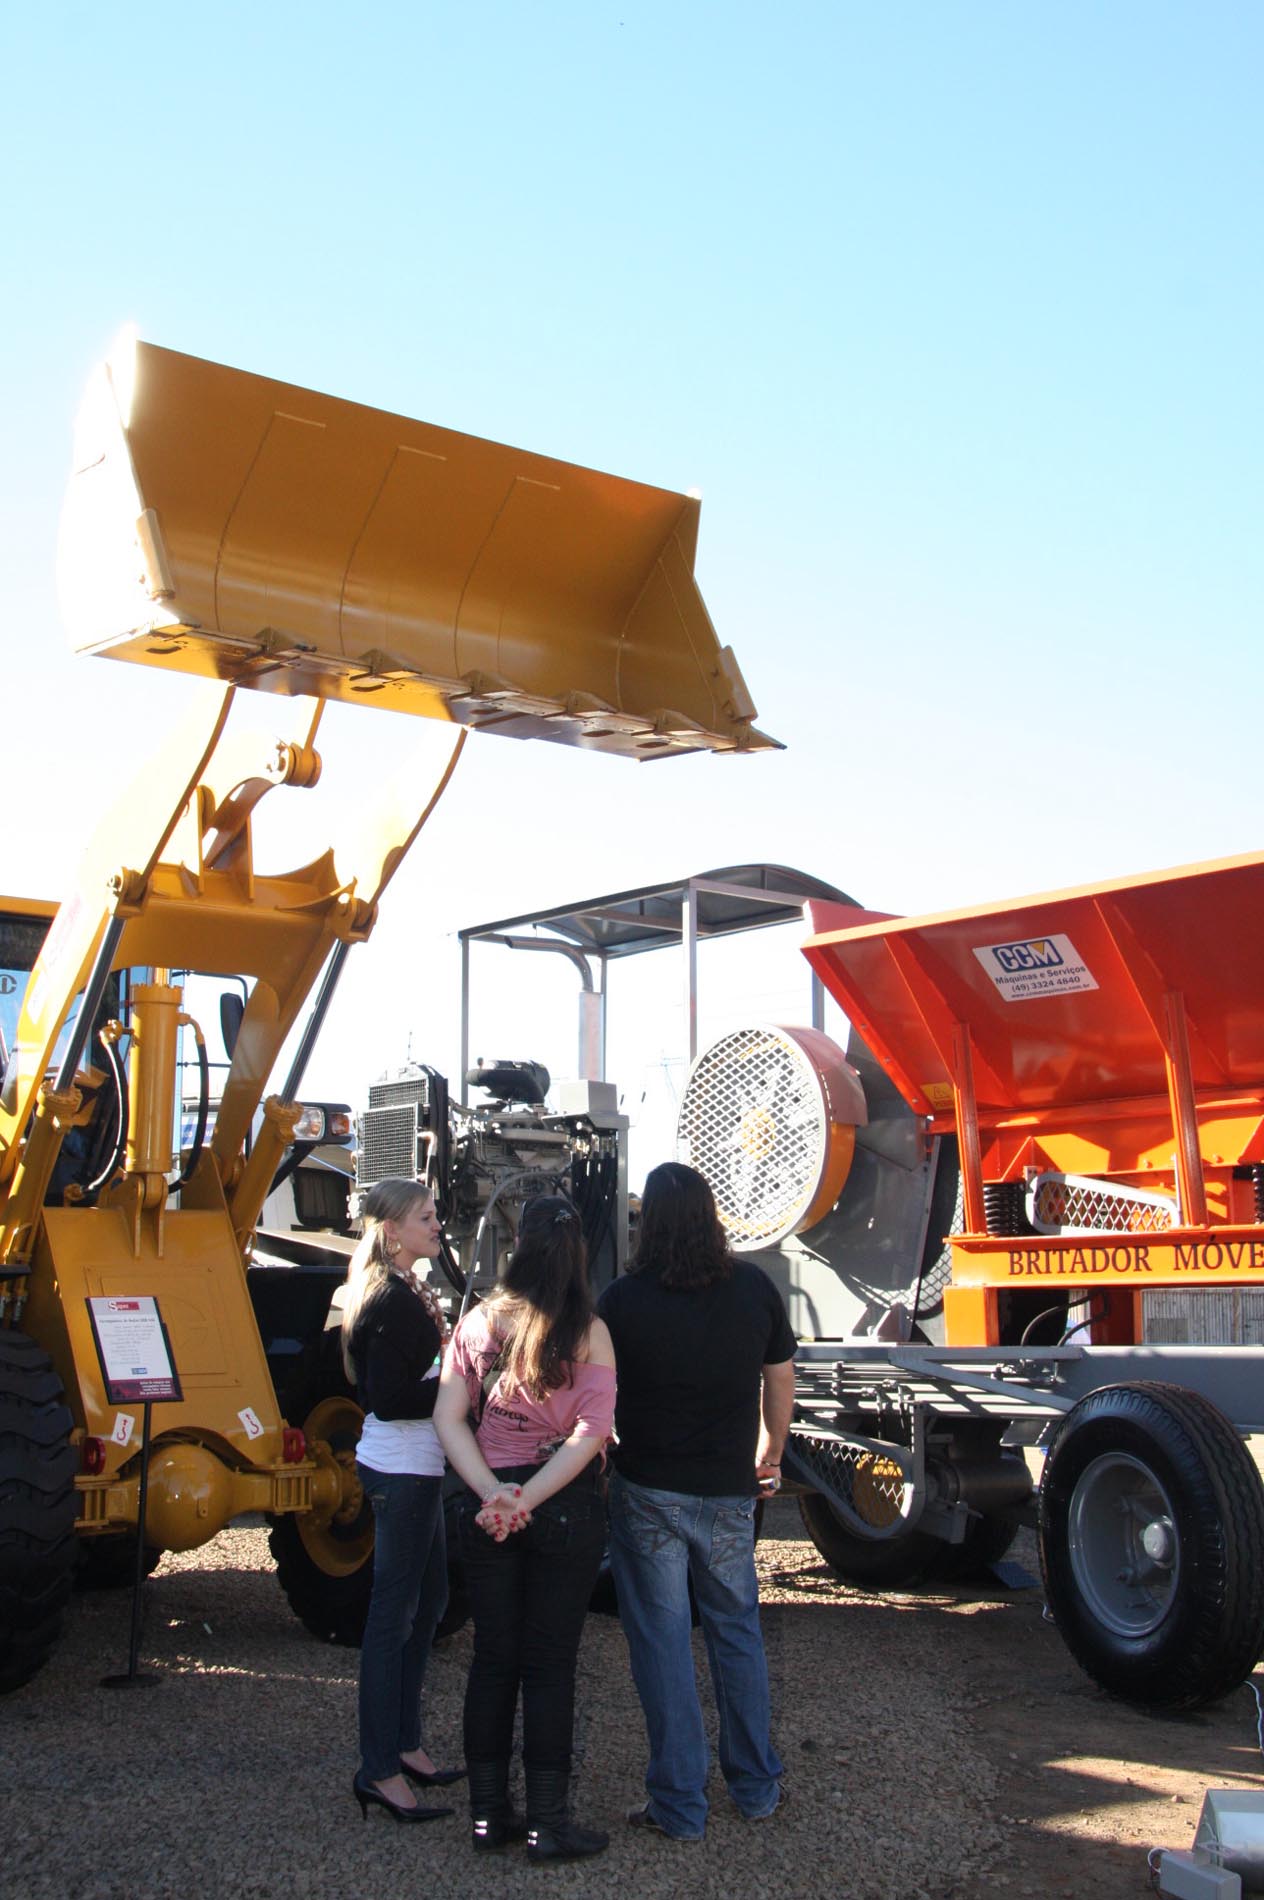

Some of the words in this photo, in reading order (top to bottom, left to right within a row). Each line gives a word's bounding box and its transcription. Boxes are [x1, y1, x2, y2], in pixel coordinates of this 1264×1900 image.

[997, 941, 1060, 970] CCM
[1046, 966, 1086, 978] Serviços
[1012, 984, 1030, 993] (49)
[1032, 980, 1055, 990] 3324
[1056, 975, 1080, 986] 4840
[1008, 1246, 1152, 1275] BRITADOR
